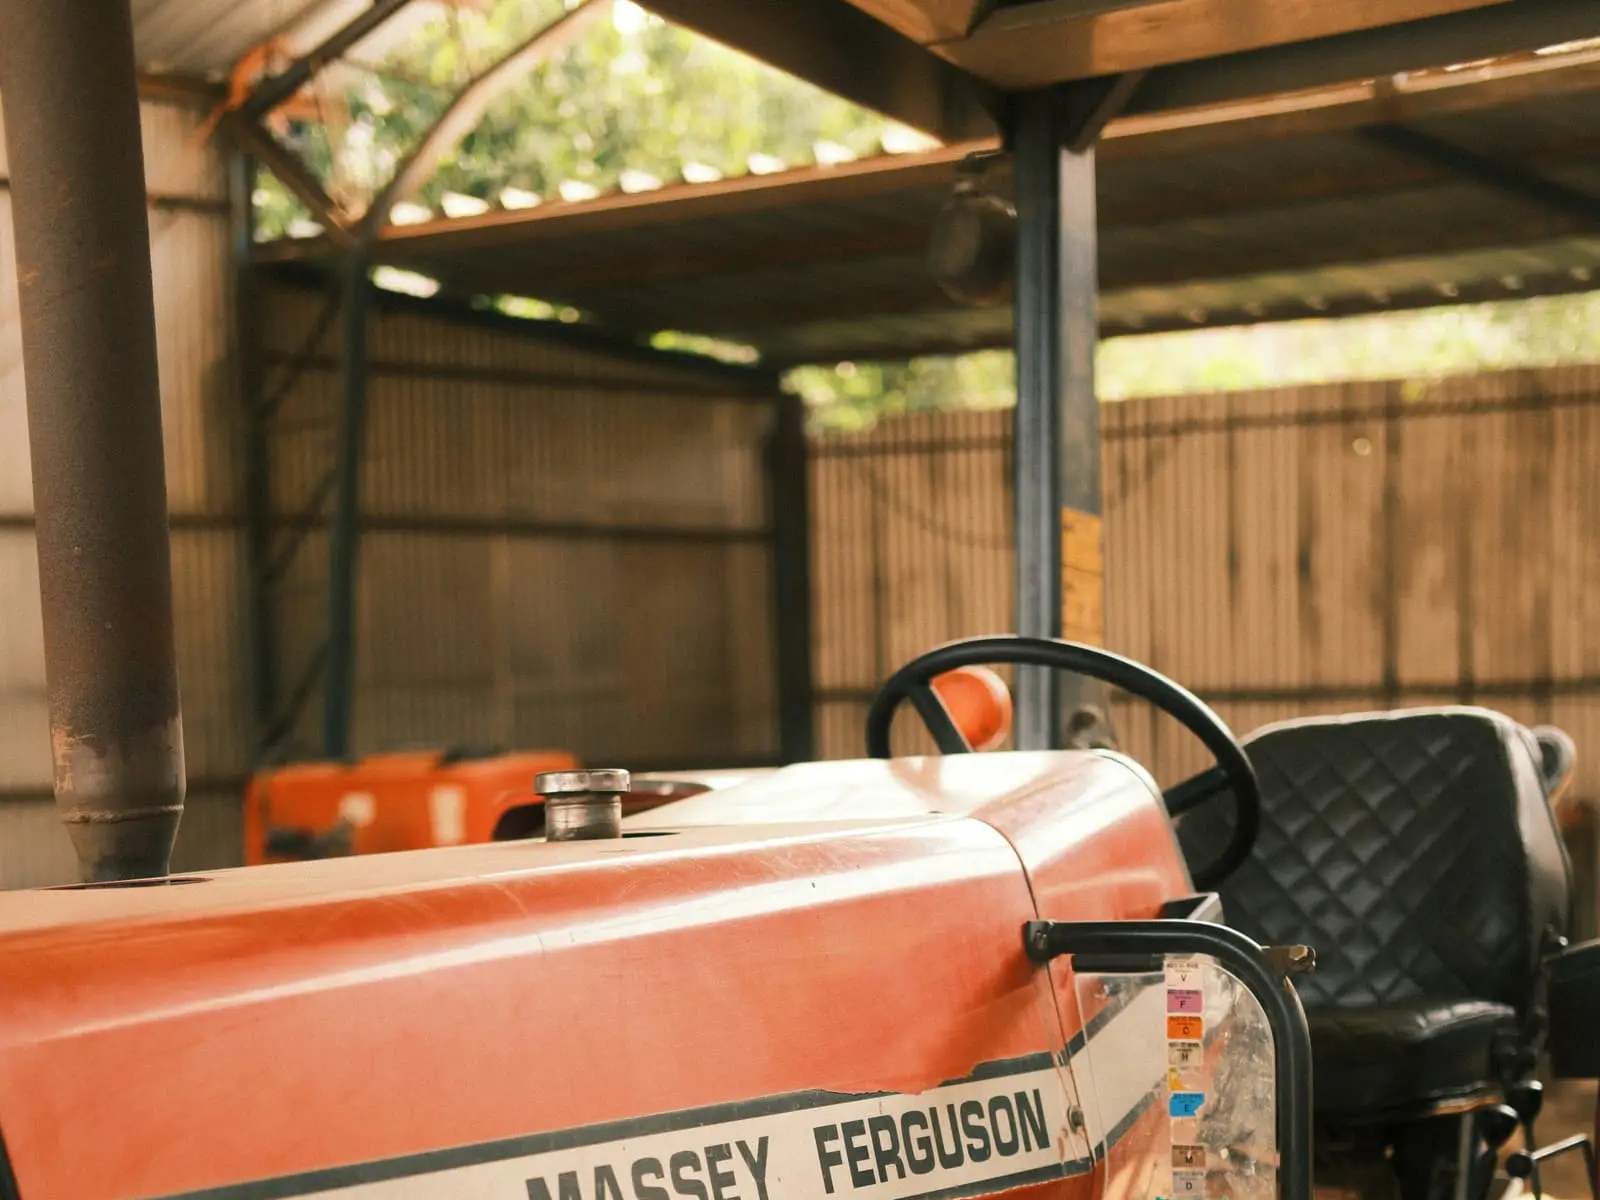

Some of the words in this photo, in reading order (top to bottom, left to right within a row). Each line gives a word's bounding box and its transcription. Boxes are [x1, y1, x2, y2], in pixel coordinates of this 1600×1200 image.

[1181, 974, 1187, 982] V
[1180, 1000, 1186, 1009] F
[1182, 1026, 1189, 1035] C
[1184, 1103, 1190, 1113] E
[813, 1088, 1050, 1194] FERGUSON
[1185, 1154, 1193, 1164] M
[1185, 1181, 1193, 1191] D
